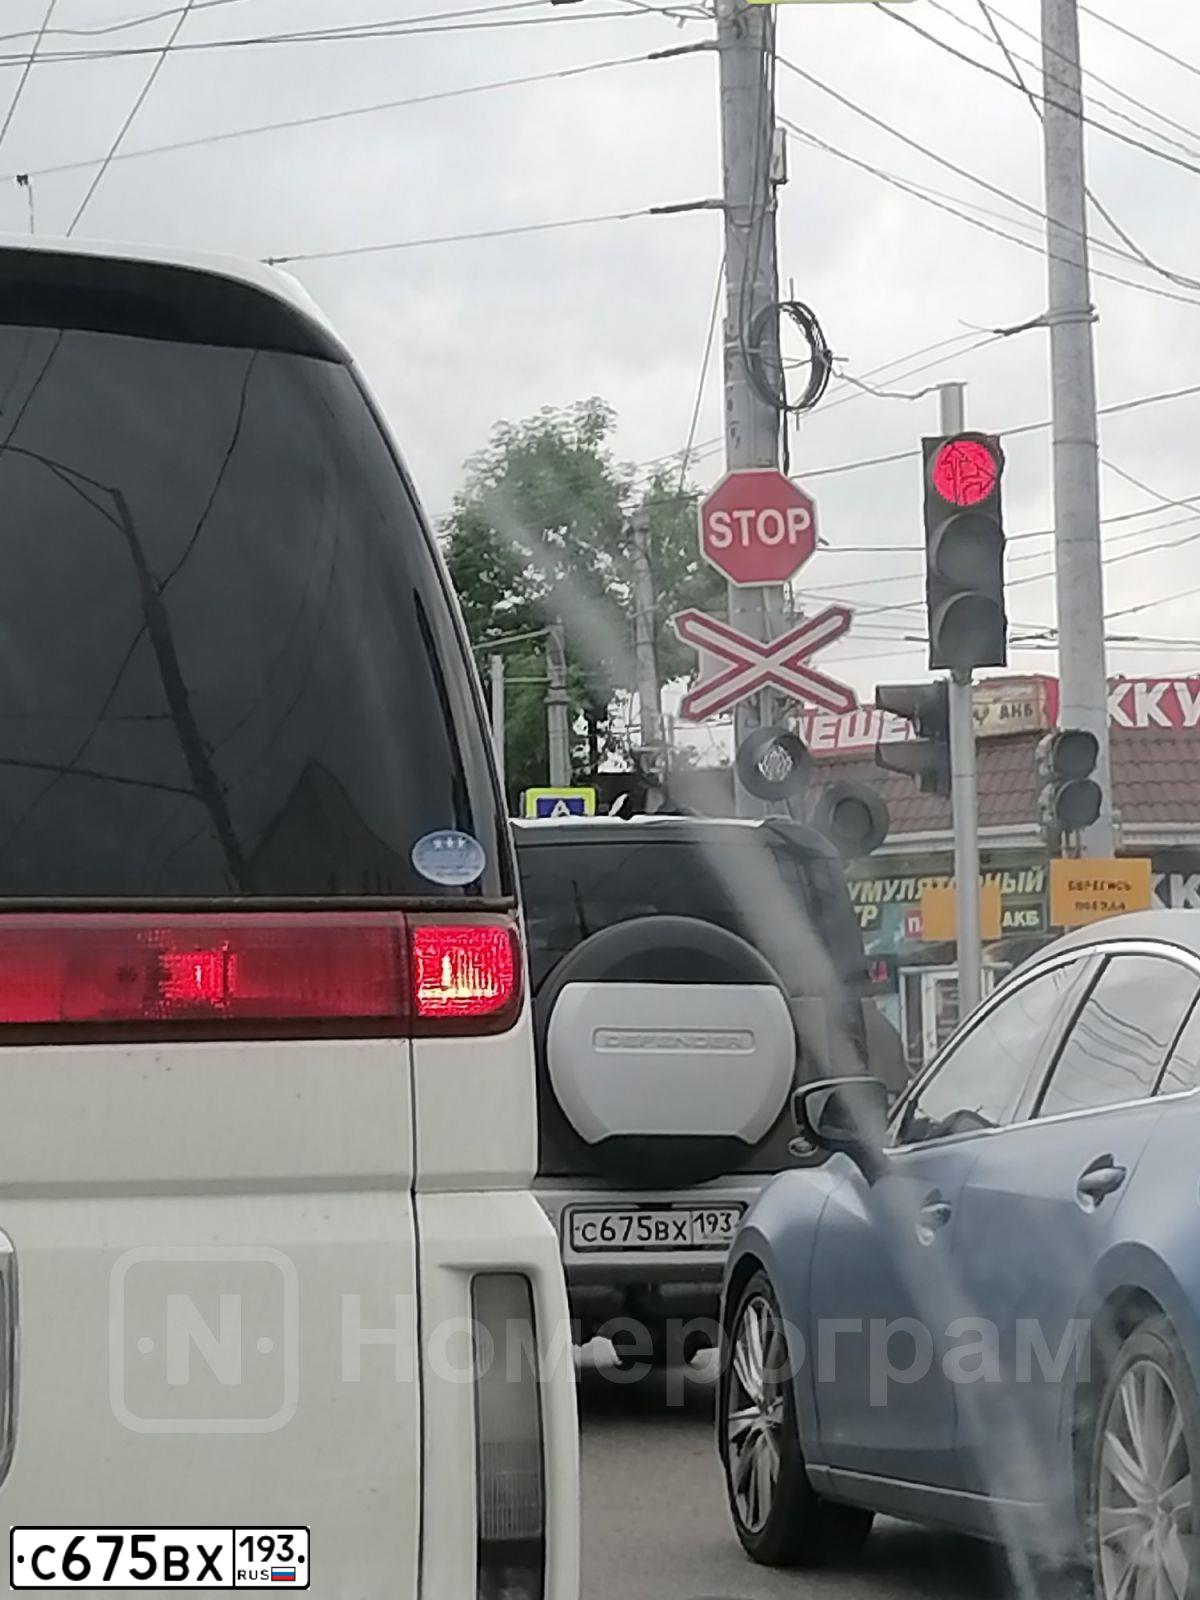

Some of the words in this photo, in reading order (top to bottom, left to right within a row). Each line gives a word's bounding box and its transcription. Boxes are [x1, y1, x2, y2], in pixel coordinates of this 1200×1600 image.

[708, 507, 811, 548] STOP
[999, 703, 1033, 721] АКБ
[800, 707, 917, 749] ЕШЕ
[1002, 910, 1040, 928] АКБ
[581, 1215, 687, 1243] С675ВХ
[692, 1212, 733, 1234] 193
